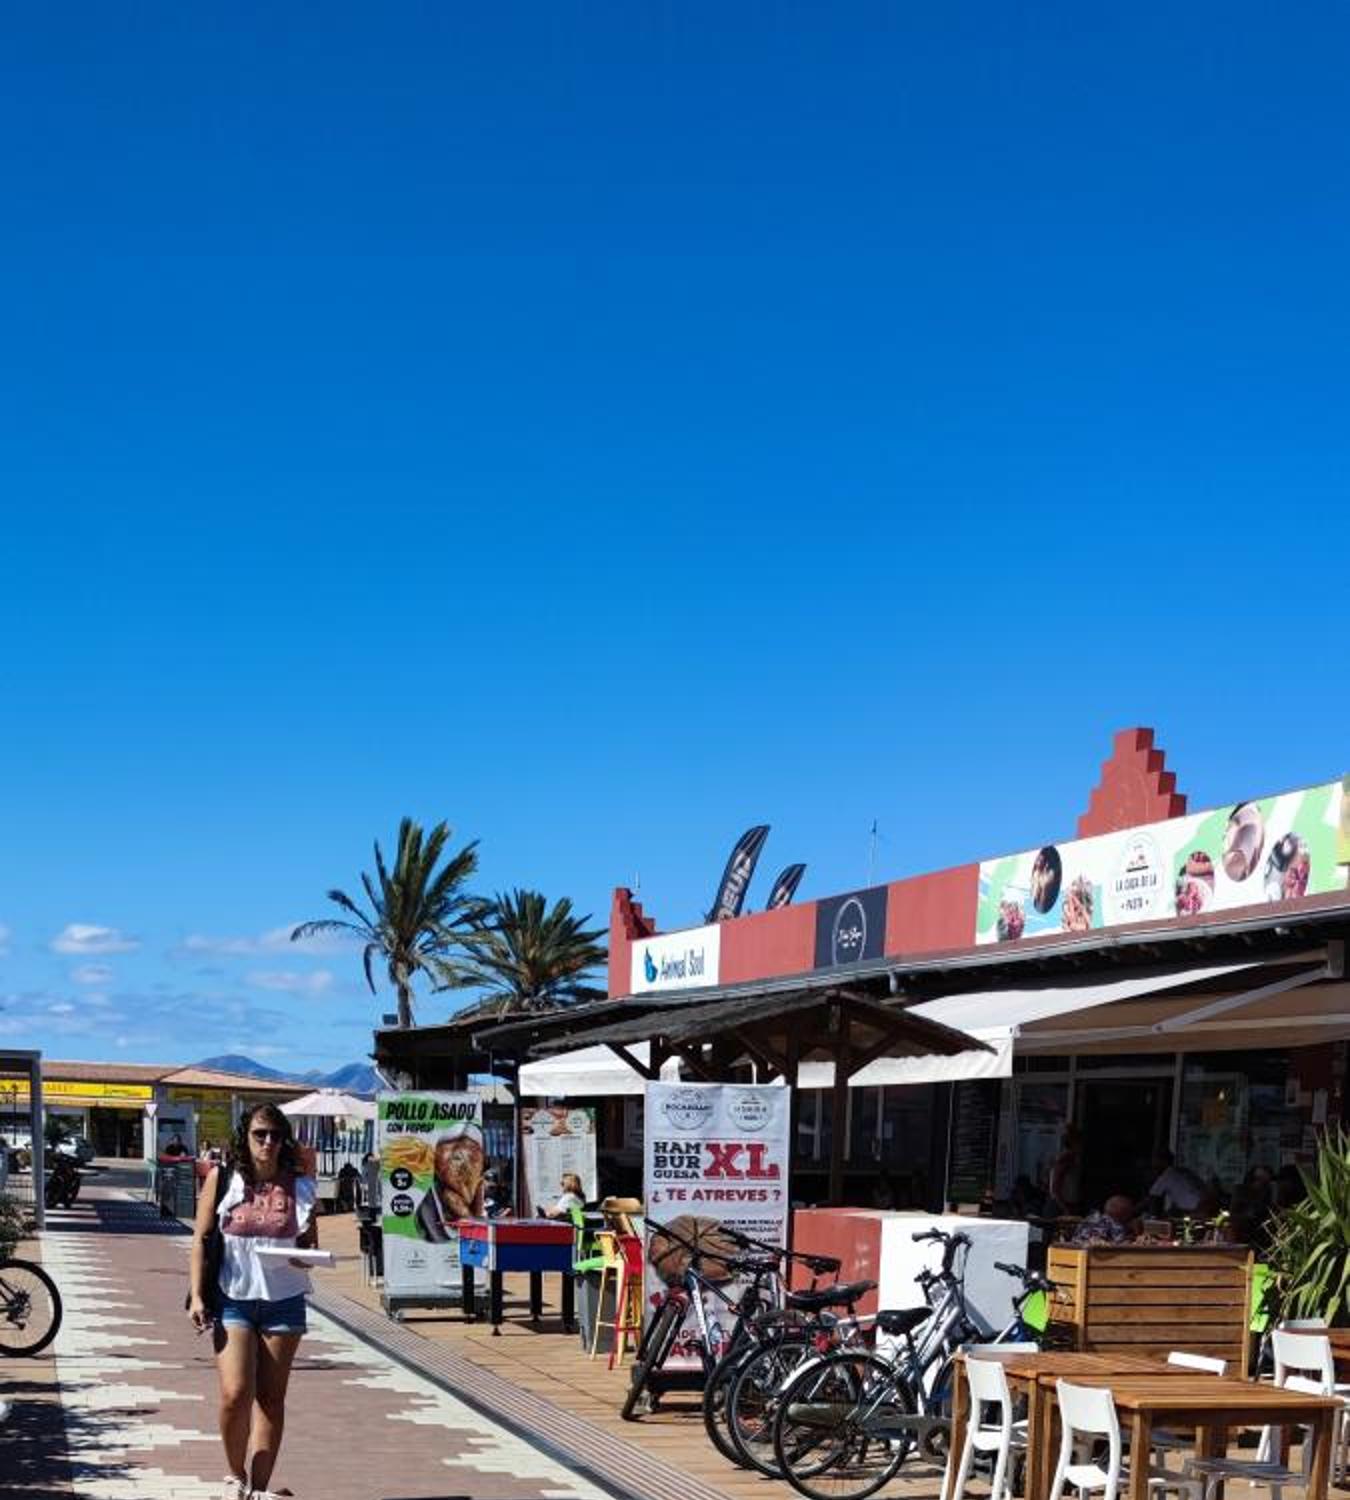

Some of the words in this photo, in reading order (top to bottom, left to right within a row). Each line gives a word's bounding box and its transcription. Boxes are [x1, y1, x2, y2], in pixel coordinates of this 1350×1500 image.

[386, 1102, 428, 1120] POLLO
[430, 1102, 477, 1120] ASADO
[653, 1141, 702, 1154] HAM
[654, 1155, 701, 1169] BUR
[703, 1143, 780, 1180] XL
[653, 1169, 700, 1179] GUESA
[666, 1188, 687, 1201] TE
[692, 1188, 767, 1201] ATREVES
[772, 1188, 781, 1201] ?
